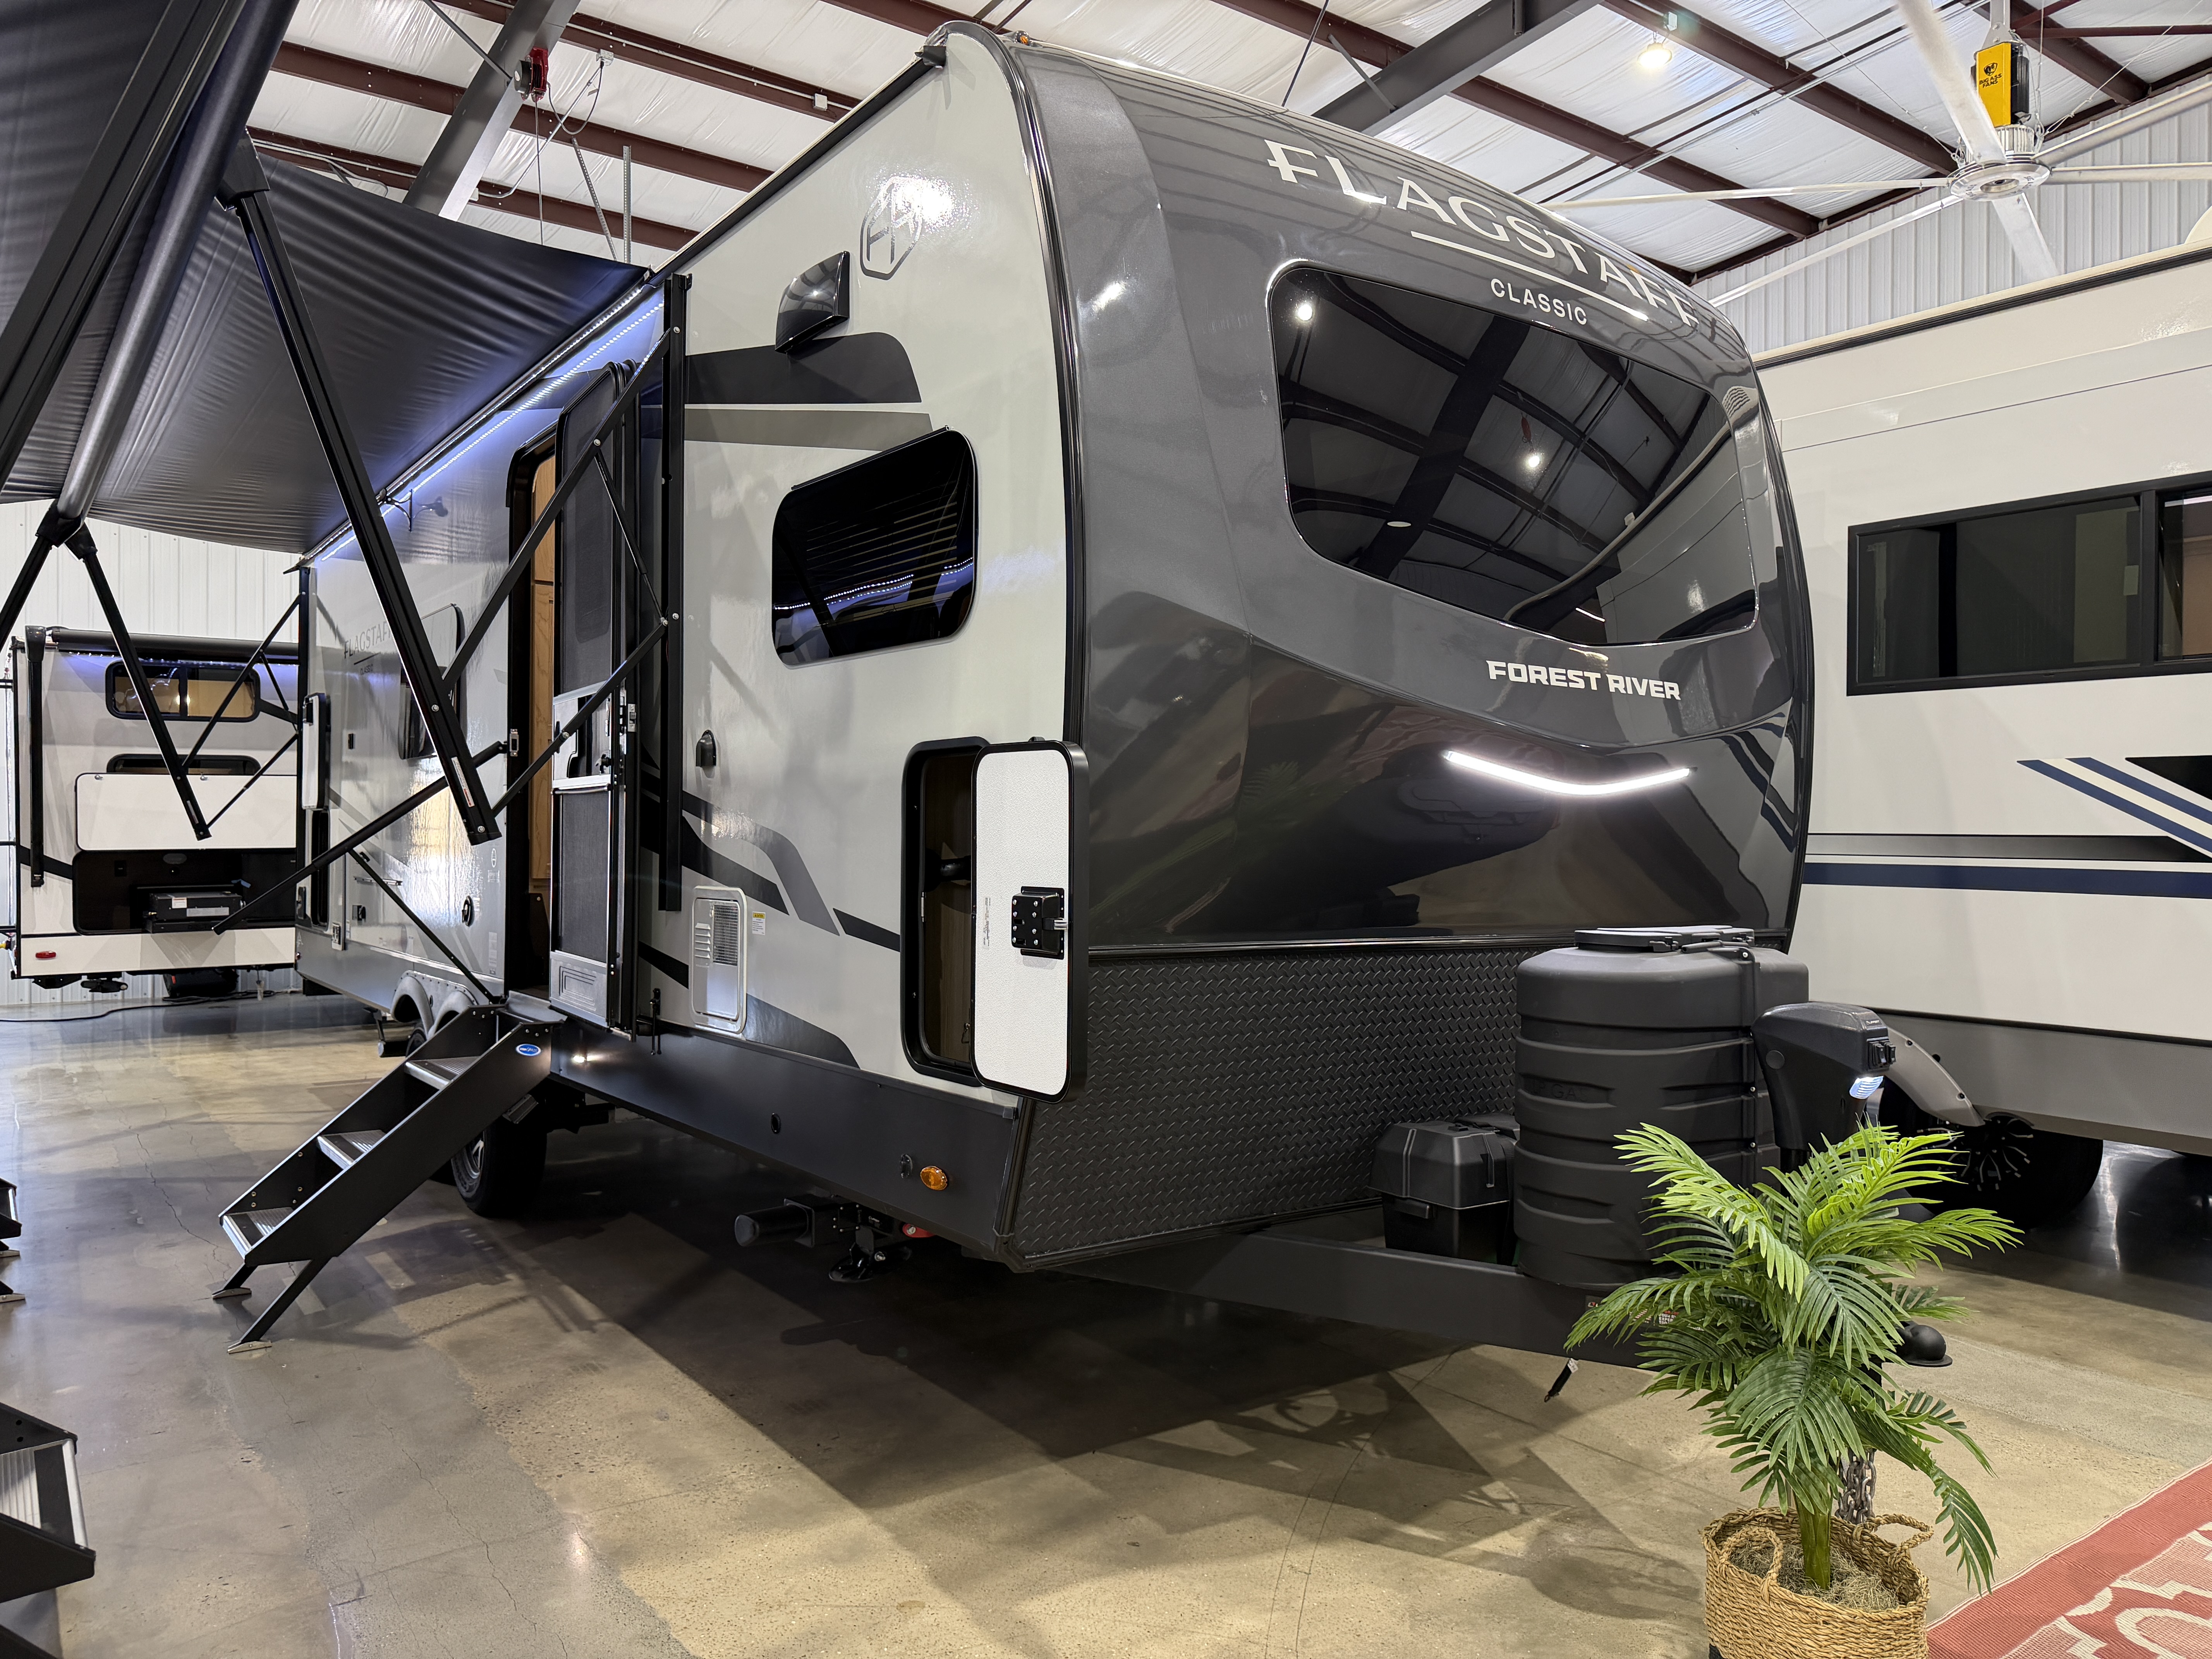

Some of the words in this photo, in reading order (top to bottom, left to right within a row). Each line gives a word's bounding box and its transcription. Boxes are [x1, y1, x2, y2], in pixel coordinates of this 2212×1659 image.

[1983, 79, 1998, 88] FANS
[1264, 139, 1699, 326] FLAGSTAFF
[1490, 278, 1588, 326] CLASSIC
[1486, 660, 1601, 691] FOREST
[1606, 673, 1681, 700] RIVER
